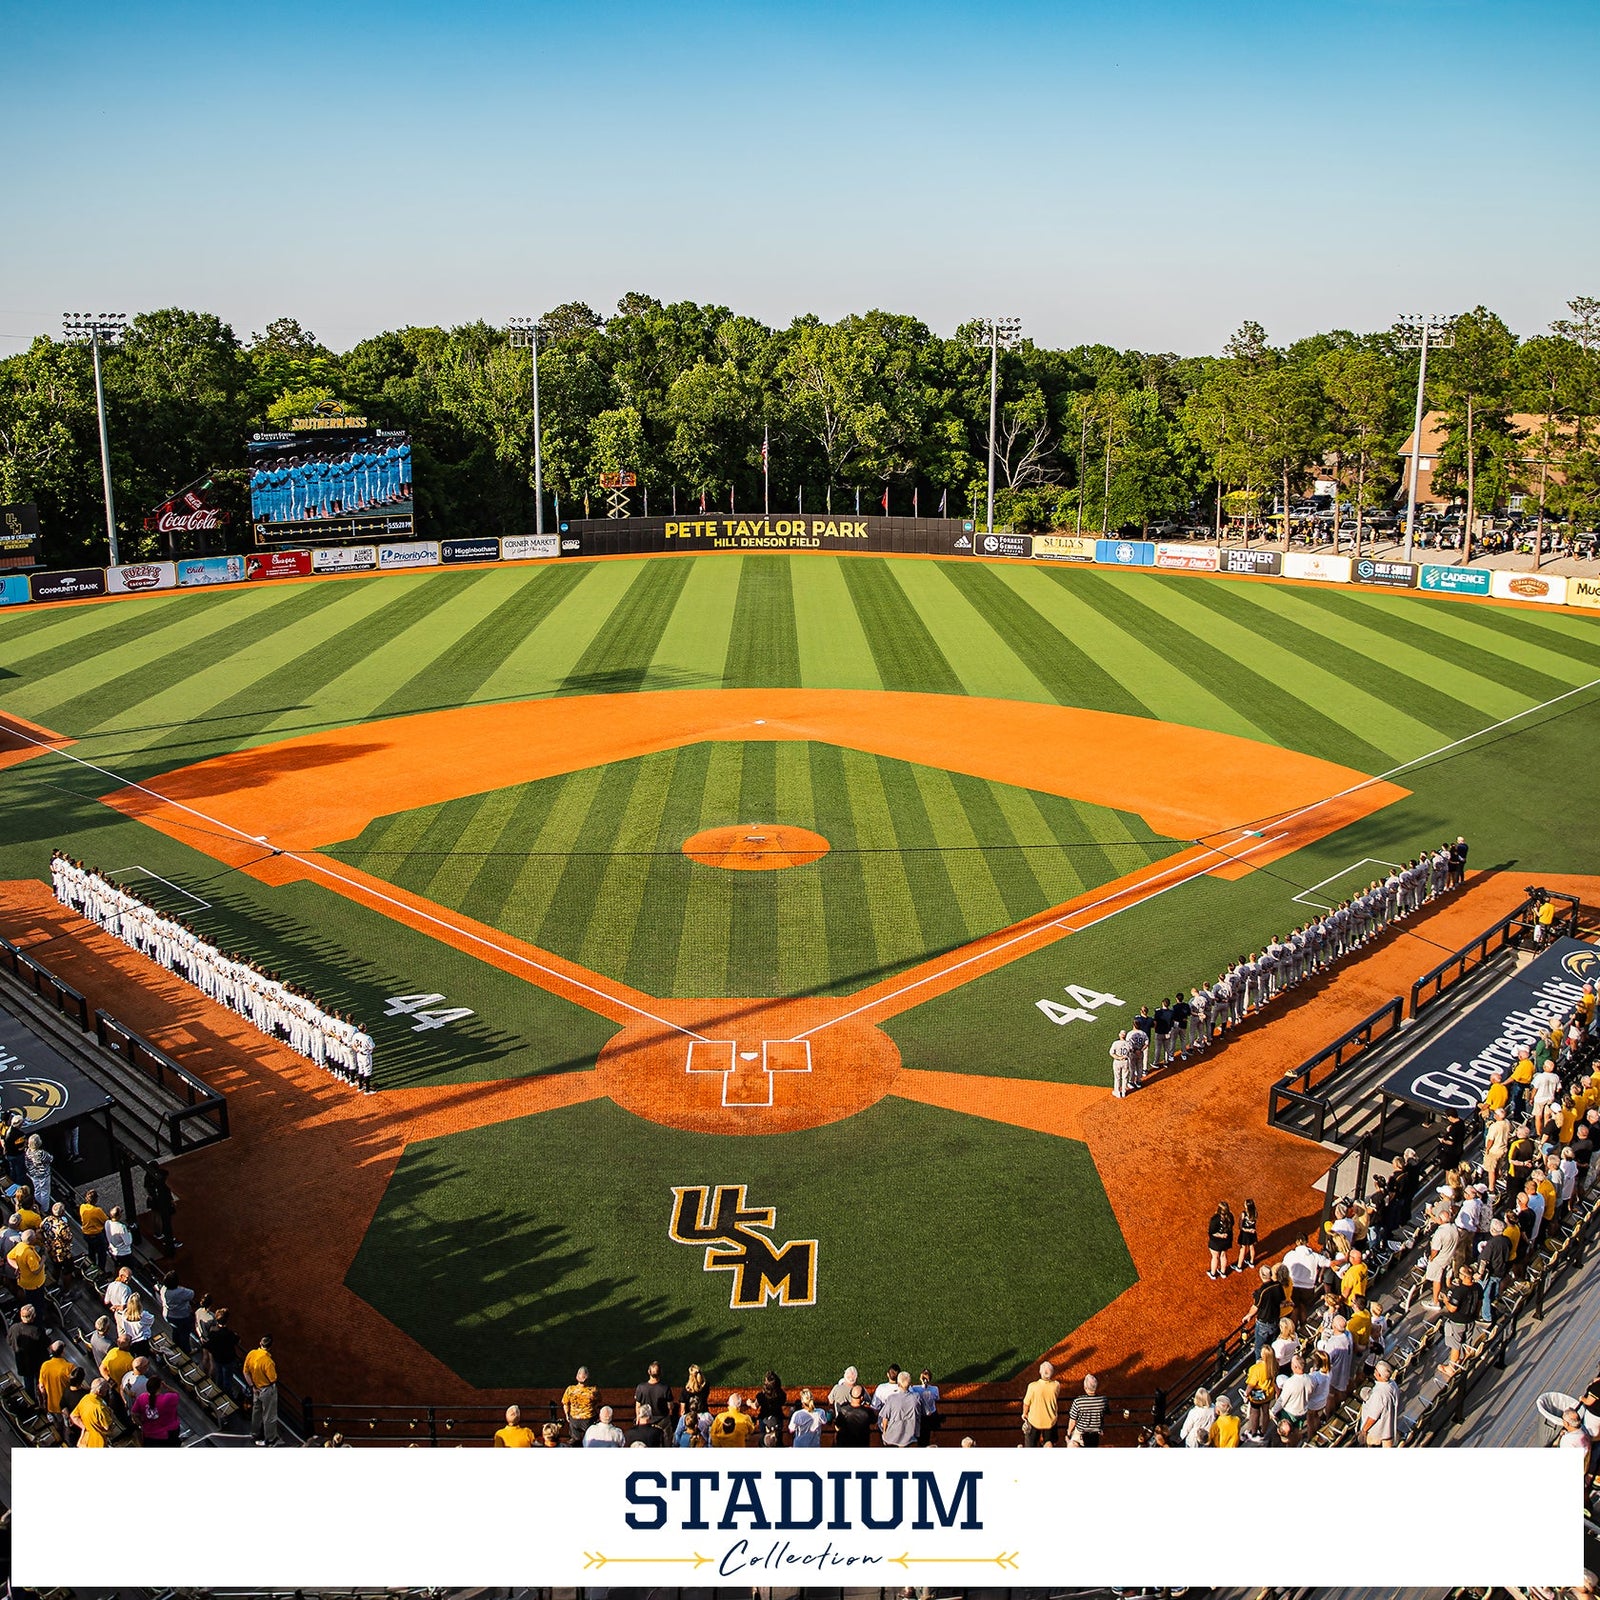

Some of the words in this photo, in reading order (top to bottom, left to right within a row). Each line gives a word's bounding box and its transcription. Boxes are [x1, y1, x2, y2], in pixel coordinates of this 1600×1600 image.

[291, 418, 343, 430] SOUTHERN
[343, 416, 368, 429] MISS
[158, 509, 219, 532] Coca-Cola
[665, 520, 717, 538] PETE
[722, 520, 807, 537] TAYLOR
[812, 520, 868, 538] PARK
[504, 540, 529, 548] CORNER
[530, 538, 556, 547] MARKET
[714, 538, 738, 547] HILL
[741, 537, 788, 547] DENSON
[790, 538, 820, 547] FIELD
[999, 536, 1024, 544] FORREST
[394, 550, 437, 560] PriorityOne
[455, 546, 496, 554] Higginbotham
[1228, 551, 1273, 564] POWER
[1228, 560, 1255, 572] ADE
[1374, 563, 1390, 574] GULF
[1391, 565, 1412, 576] SOUTH
[1440, 572, 1486, 585] CADENCE
[39, 584, 78, 594] COMMUNITY
[79, 583, 98, 591] BANK
[1035, 984, 1126, 1025] 44
[383, 993, 474, 1032] 44
[668, 1185, 818, 1309] USM
